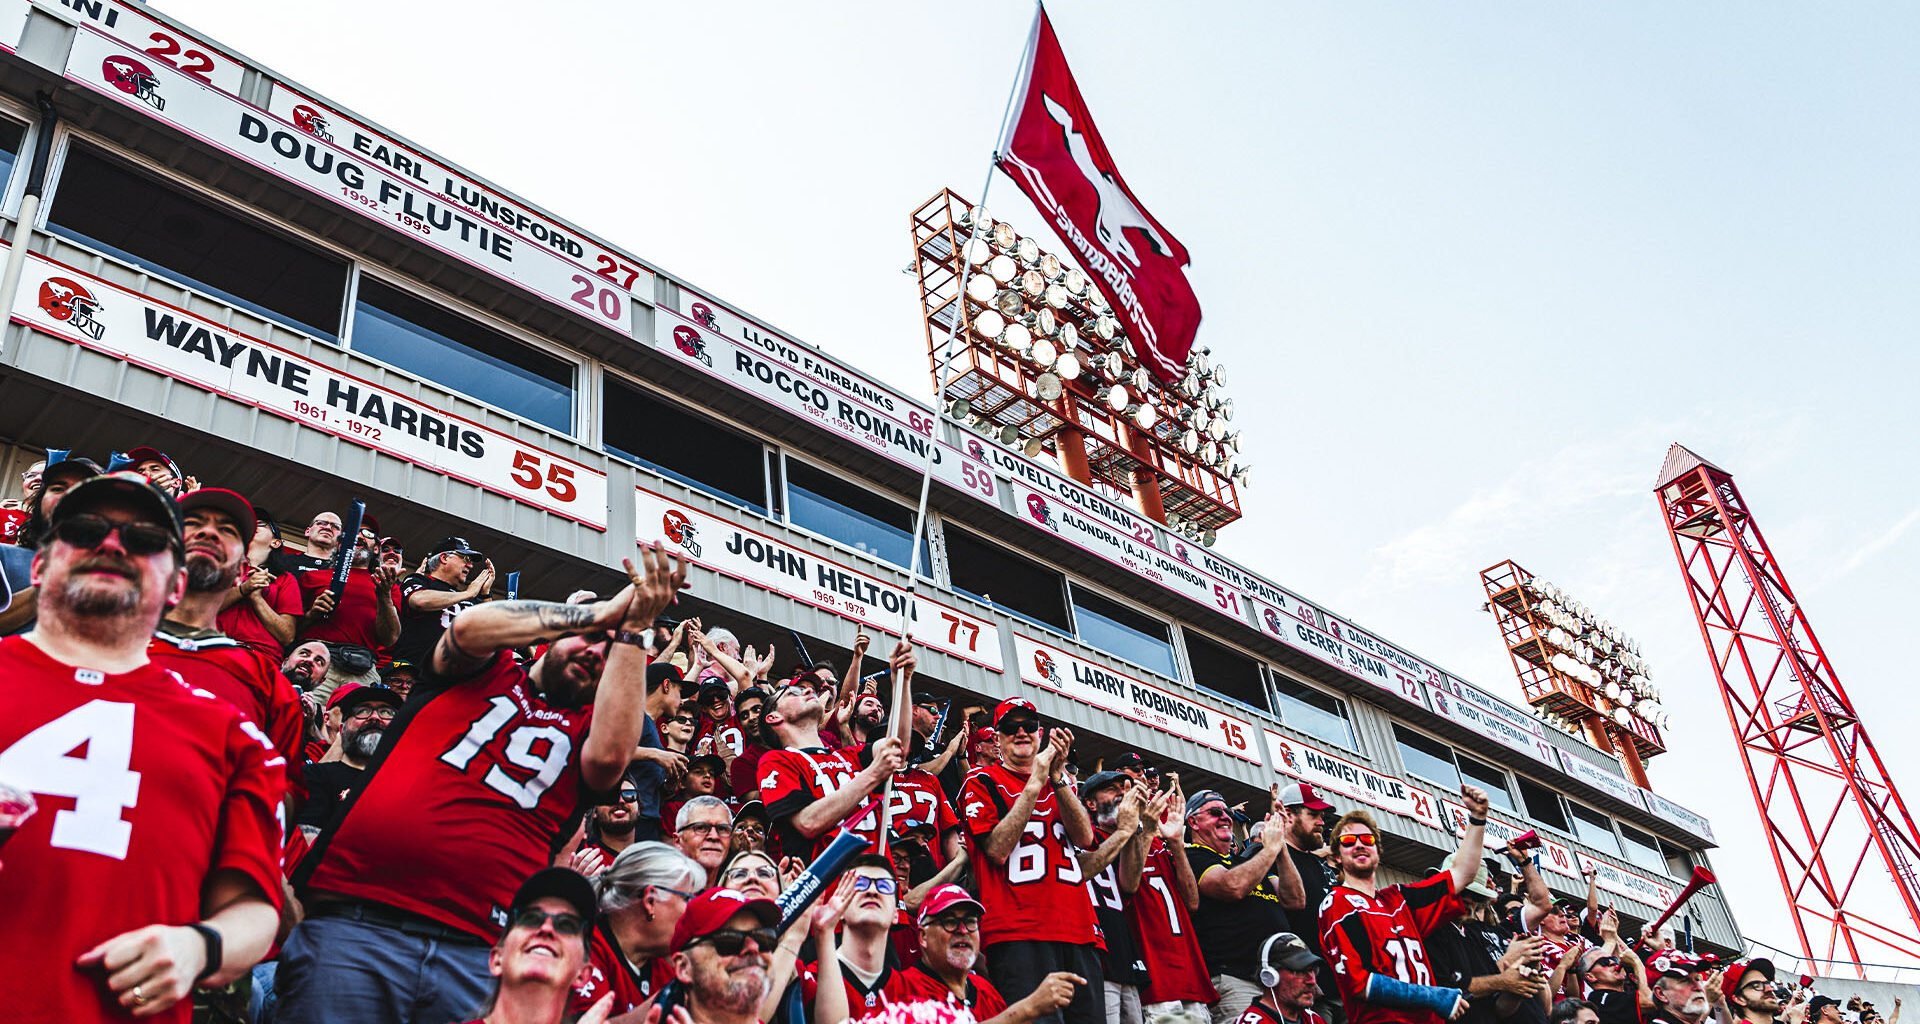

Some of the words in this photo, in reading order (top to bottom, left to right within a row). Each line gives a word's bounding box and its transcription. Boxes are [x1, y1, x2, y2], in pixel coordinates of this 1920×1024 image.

[145, 32, 215, 84] 22
[239, 112, 364, 190] DOUG
[379, 180, 512, 262] FLUTIE
[570, 274, 621, 321] 20
[340, 187, 378, 210] 1992
[394, 212, 431, 235] 1995
[353, 132, 429, 184] EARL
[445, 178, 583, 258] LUNSFORD
[596, 254, 639, 291] 27
[743, 326, 799, 364] LLOYD
[804, 357, 894, 412] FAIRBANKS
[144, 307, 311, 396] WAYNE
[326, 378, 485, 458] HARRIS
[510, 450, 577, 502] 55
[292, 400, 327, 422] 1961
[346, 419, 382, 442] 1972
[735, 350, 829, 411] ROCCO
[837, 399, 942, 465] ROMANO
[961, 460, 994, 497] 59
[831, 416, 856, 434] 1992
[864, 431, 887, 449] 2000
[992, 449, 1056, 493] LOVELL
[1059, 483, 1132, 530] COLEMAN
[1133, 522, 1156, 549] 22
[726, 532, 807, 582] JOHN
[817, 564, 917, 622] HELTON
[940, 611, 980, 653] 77
[1062, 512, 1121, 549] ALONDRA
[1155, 557, 1208, 590] JOHNSON
[1214, 584, 1240, 615] 51
[1203, 556, 1242, 585] KEITH
[1244, 577, 1286, 607] SPAITH
[1297, 605, 1315, 626] 48
[812, 589, 835, 606] 1969
[845, 601, 866, 617] 1978
[1296, 624, 1343, 658] GERRY
[1348, 648, 1388, 679] SHAW
[1395, 673, 1420, 701] 72
[1348, 629, 1374, 650] DAVE
[1425, 669, 1441, 689] 25
[1072, 662, 1125, 699] LARRY
[1130, 684, 1209, 730] ROBINSON
[1220, 720, 1247, 751] 15
[1456, 702, 1481, 722] RUDY
[1481, 714, 1530, 746] LINTERMAN
[1536, 741, 1551, 762] 17
[0, 699, 142, 861] 4
[437, 695, 571, 810] 19
[1304, 750, 1360, 786] HARVEY
[1362, 772, 1407, 800] WYLIE
[1411, 792, 1432, 819] 21
[1008, 821, 1084, 885] 63
[1550, 845, 1568, 869] 00
[782, 875, 821, 921] esidential
[1149, 877, 1181, 934] 1
